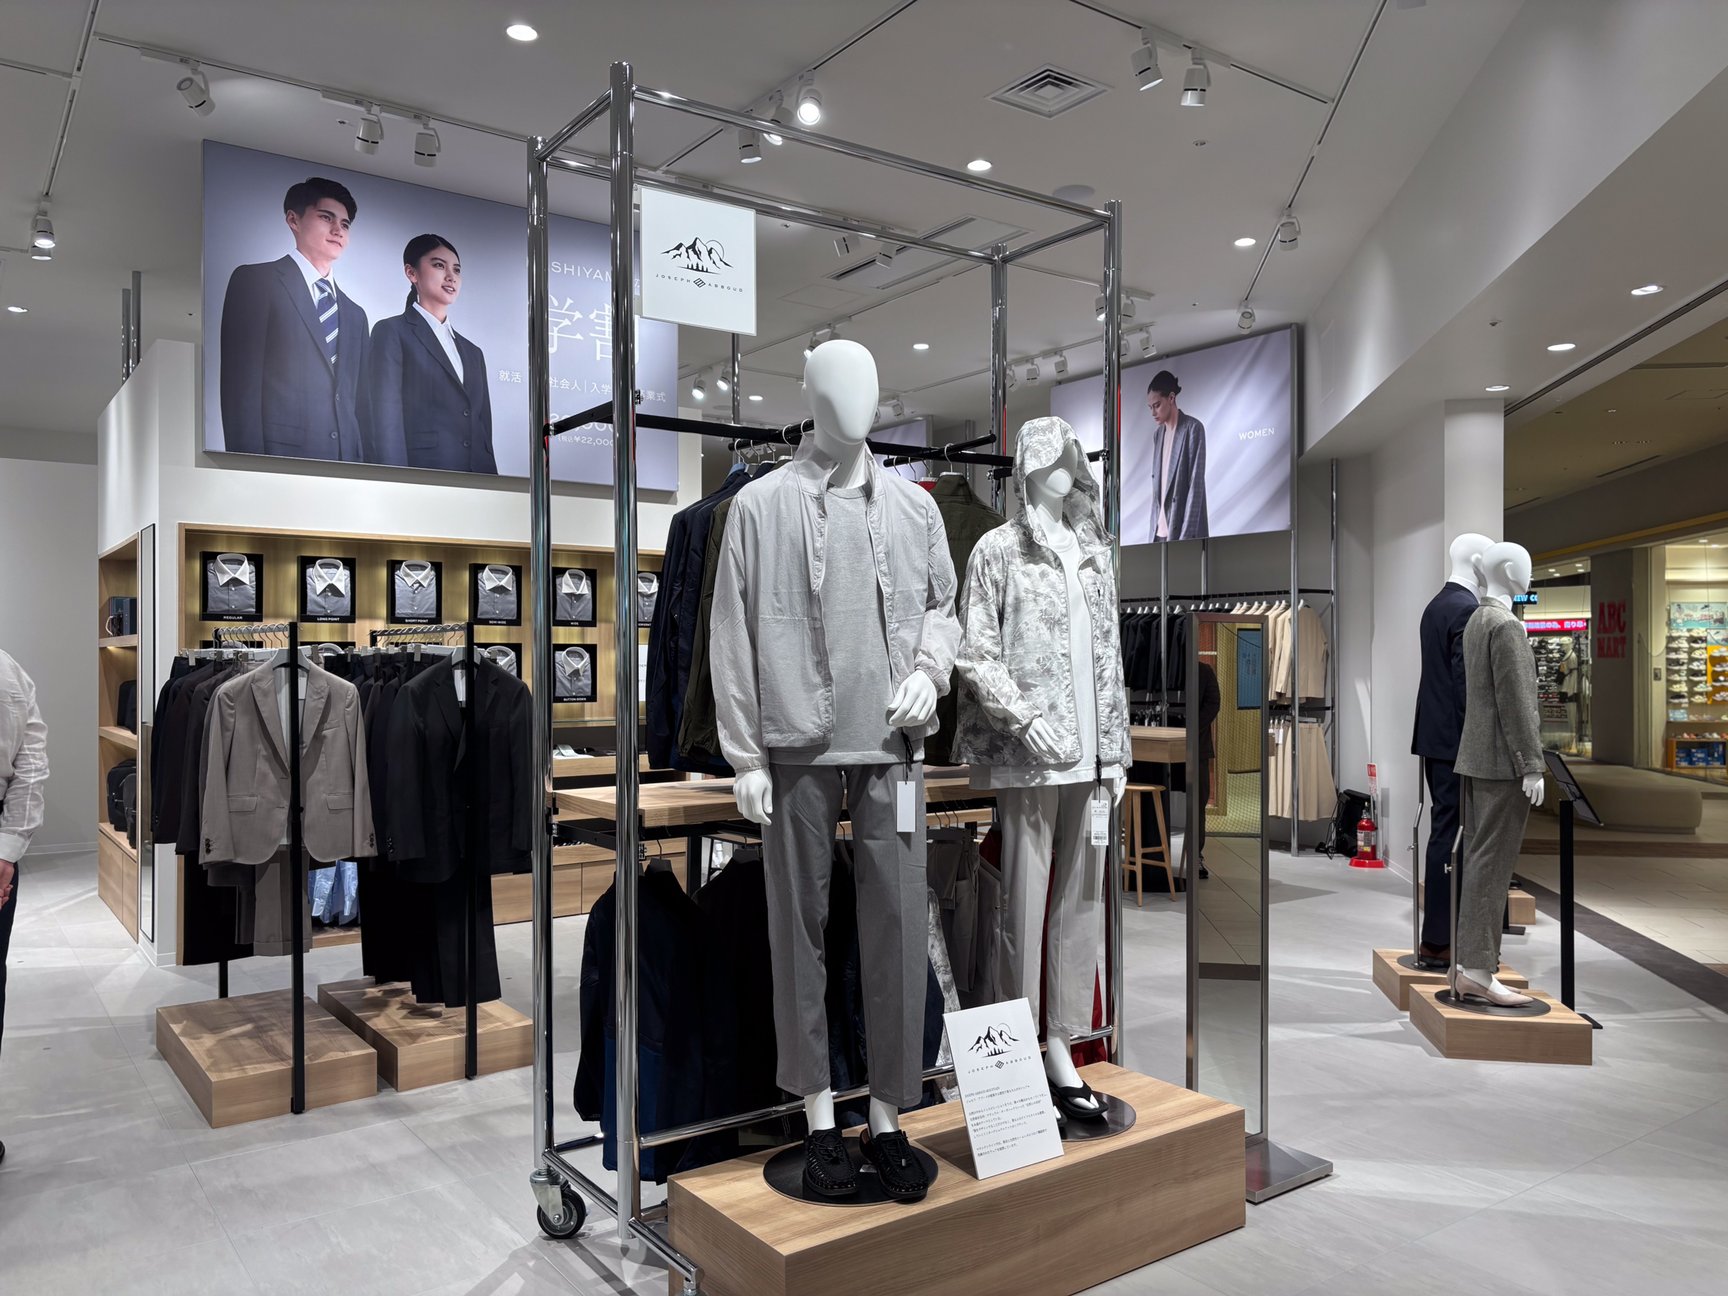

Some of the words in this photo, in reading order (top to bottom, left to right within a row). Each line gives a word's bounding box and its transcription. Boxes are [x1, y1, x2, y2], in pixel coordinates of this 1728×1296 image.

[656, 274, 690, 283] JOSEPH
[708, 283, 743, 292] ABBOUD
[498, 369, 522, 383] 就活
[1239, 428, 1274, 440] WOMEN
[1597, 601, 1626, 634] ABC
[1597, 636, 1626, 658] MART
